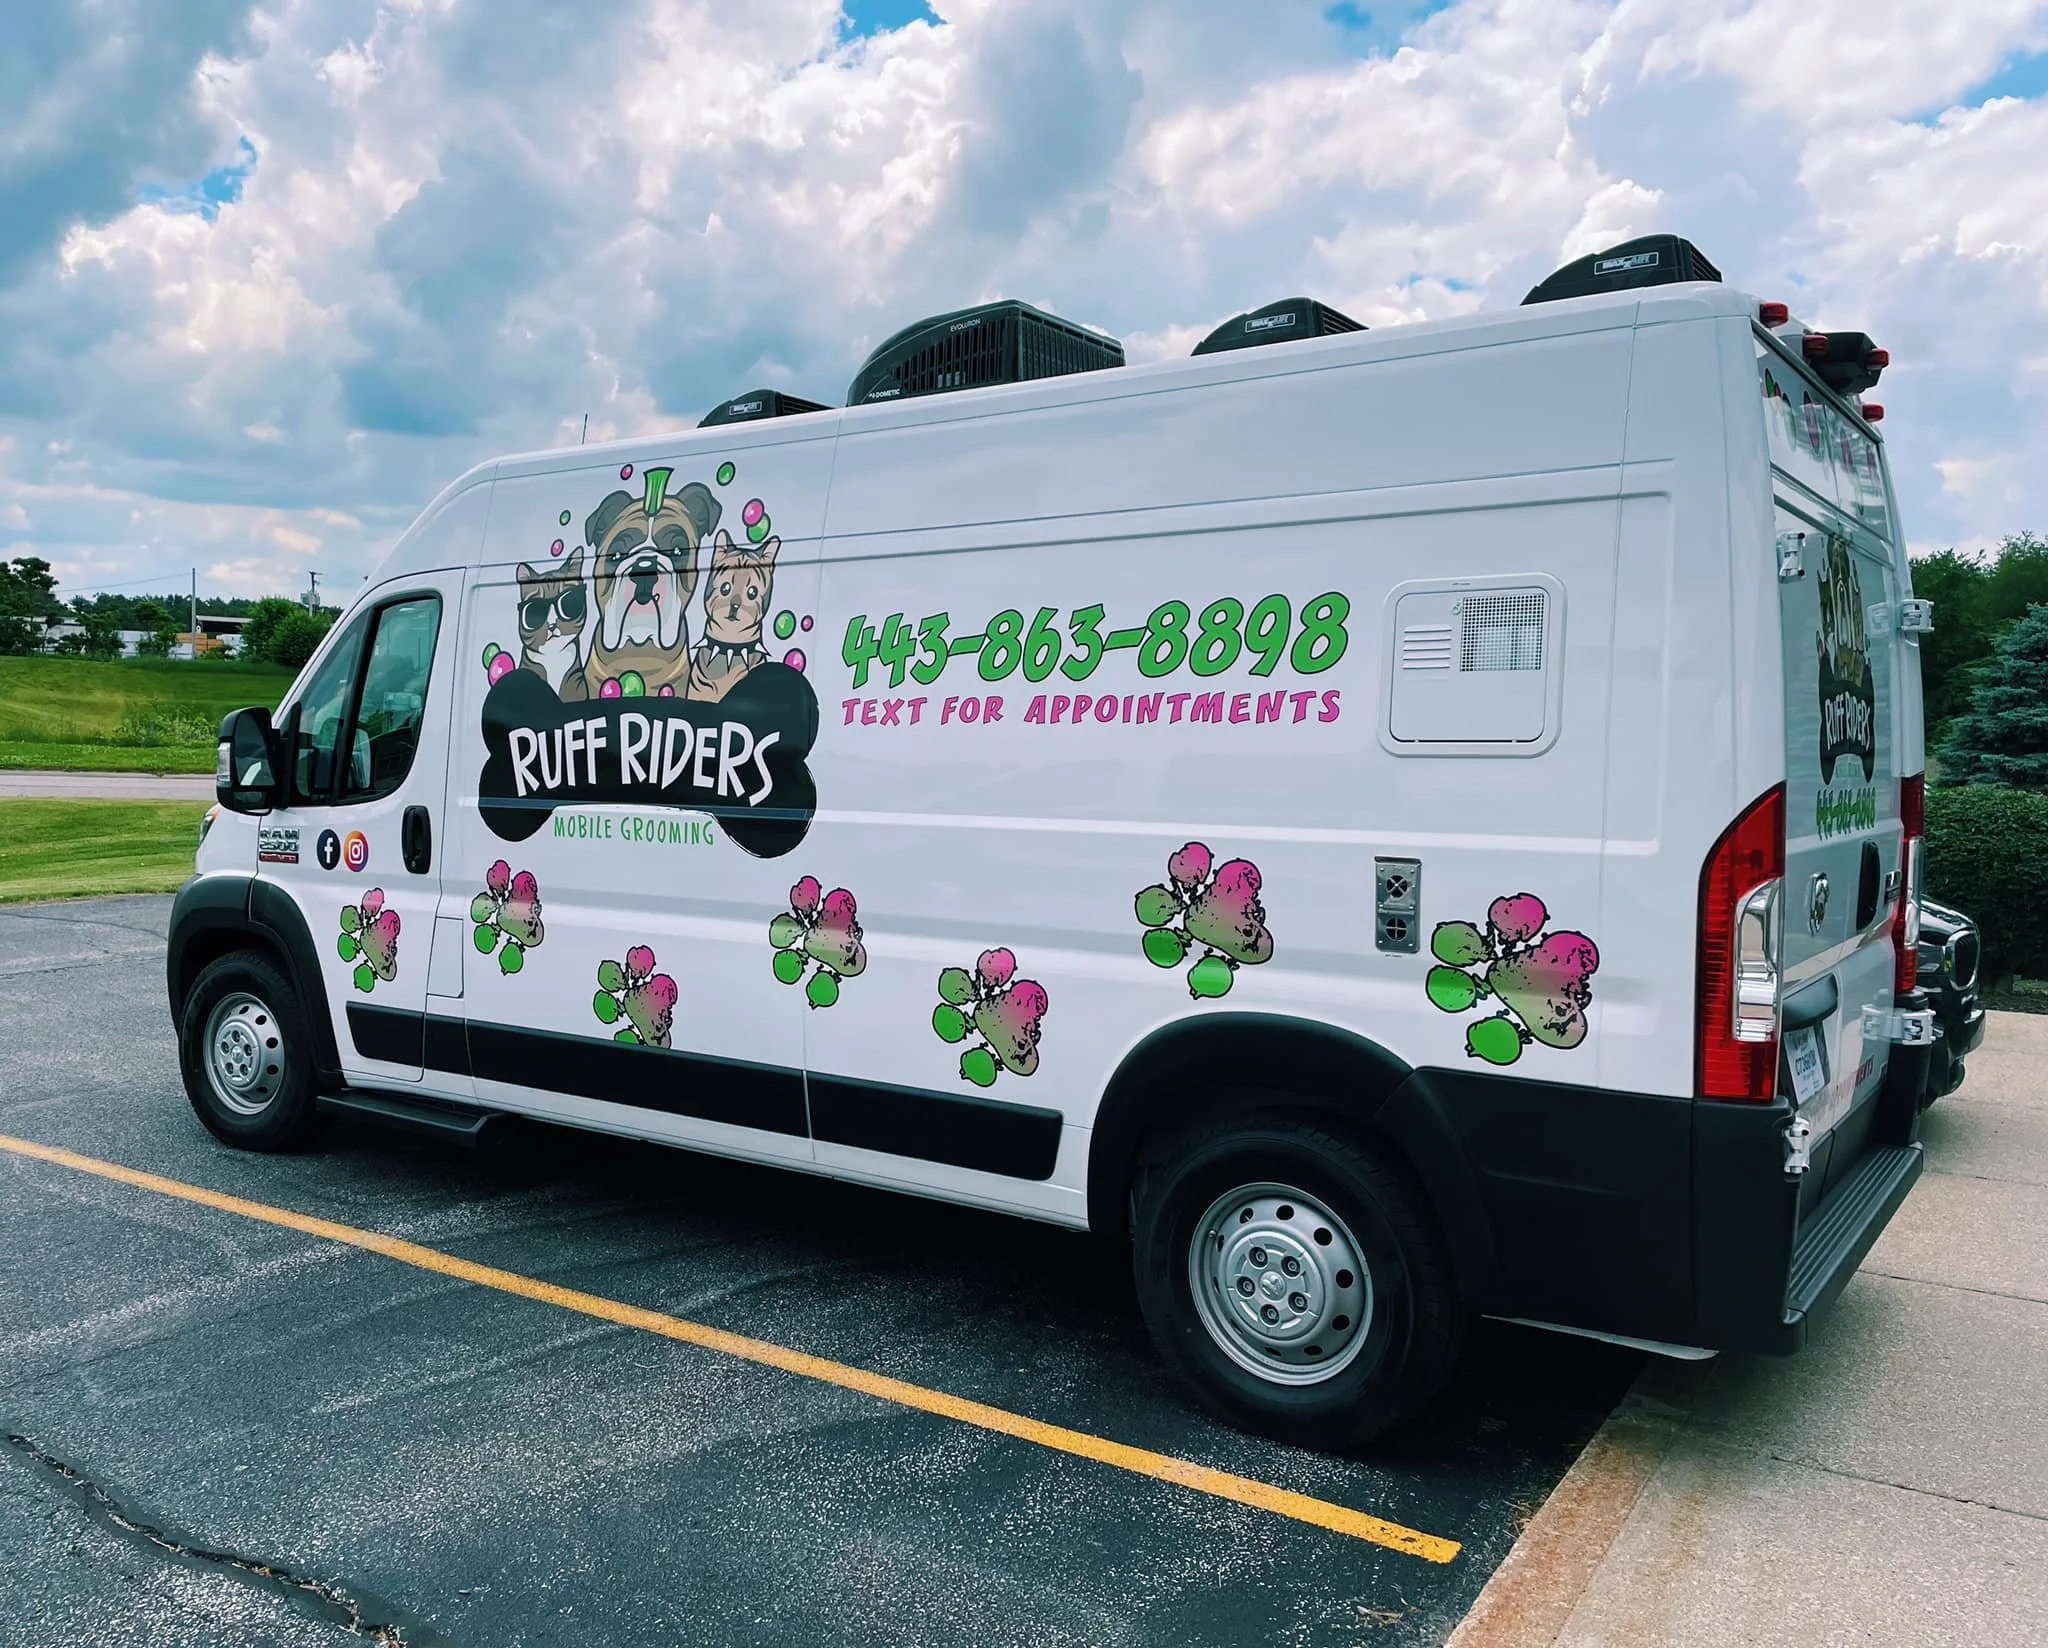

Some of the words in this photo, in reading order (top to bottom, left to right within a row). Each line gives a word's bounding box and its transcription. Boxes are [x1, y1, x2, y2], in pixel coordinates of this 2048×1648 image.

[842, 591, 1350, 689] 443-863-8898
[842, 697, 927, 725] TEXT
[941, 695, 1003, 725] FOR
[1024, 690, 1341, 725] APPOINTMENTS
[1825, 692, 1844, 750] RUFF
[1845, 691, 1870, 751] RIDERS
[508, 717, 607, 797] RUFF
[620, 712, 780, 807] RIDERS
[554, 815, 613, 839] MOBILE
[620, 817, 715, 846] GROOMING
